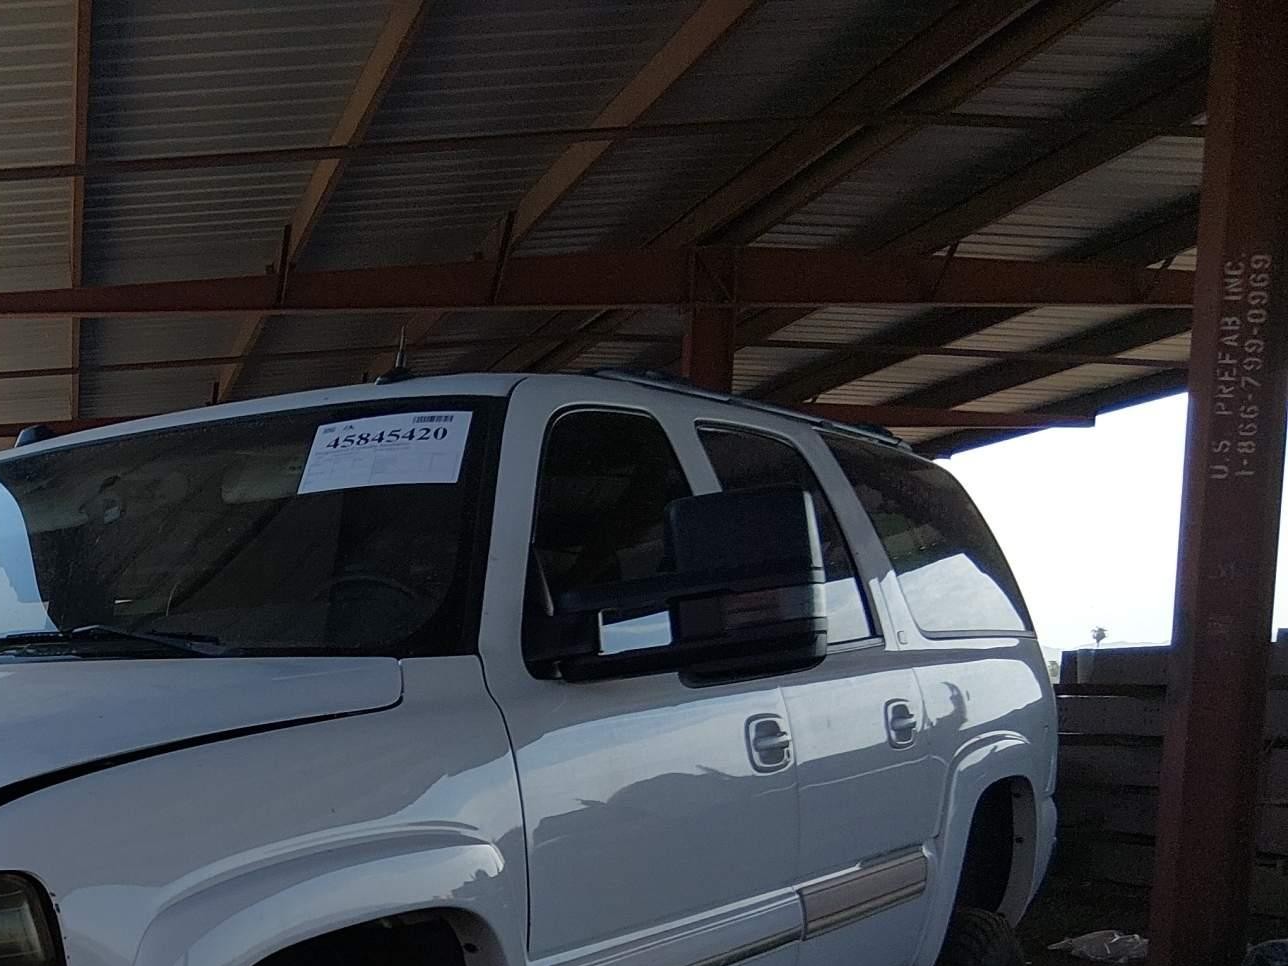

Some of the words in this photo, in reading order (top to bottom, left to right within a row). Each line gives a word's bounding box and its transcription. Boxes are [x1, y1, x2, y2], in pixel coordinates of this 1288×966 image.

[1215, 316, 1242, 415] PREFAB
[1235, 254, 1273, 477] 1-866-799-0969
[326, 427, 448, 449] 45845420
